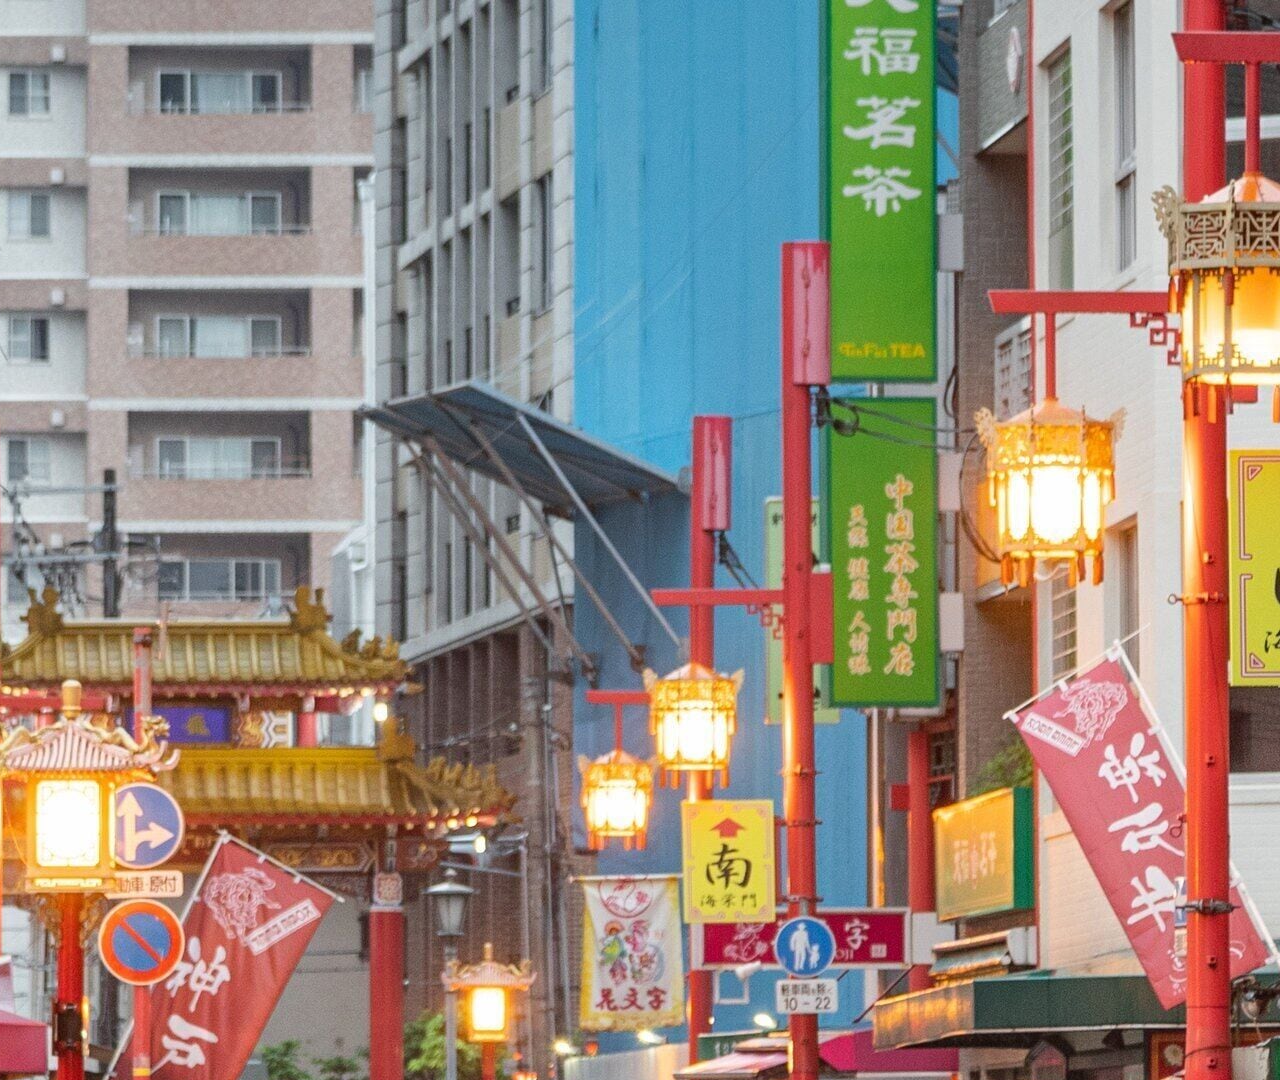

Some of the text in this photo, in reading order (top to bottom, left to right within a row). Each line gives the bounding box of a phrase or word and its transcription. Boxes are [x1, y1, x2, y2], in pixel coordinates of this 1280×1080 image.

[843, 0, 922, 217] 福茗茶
[889, 341, 926, 358] TEA
[705, 842, 752, 890] 南
[699, 892, 758, 910] 海栄門
[595, 986, 668, 1011] 花文字
[783, 996, 798, 1011] 10
[815, 996, 832, 1011] 22
